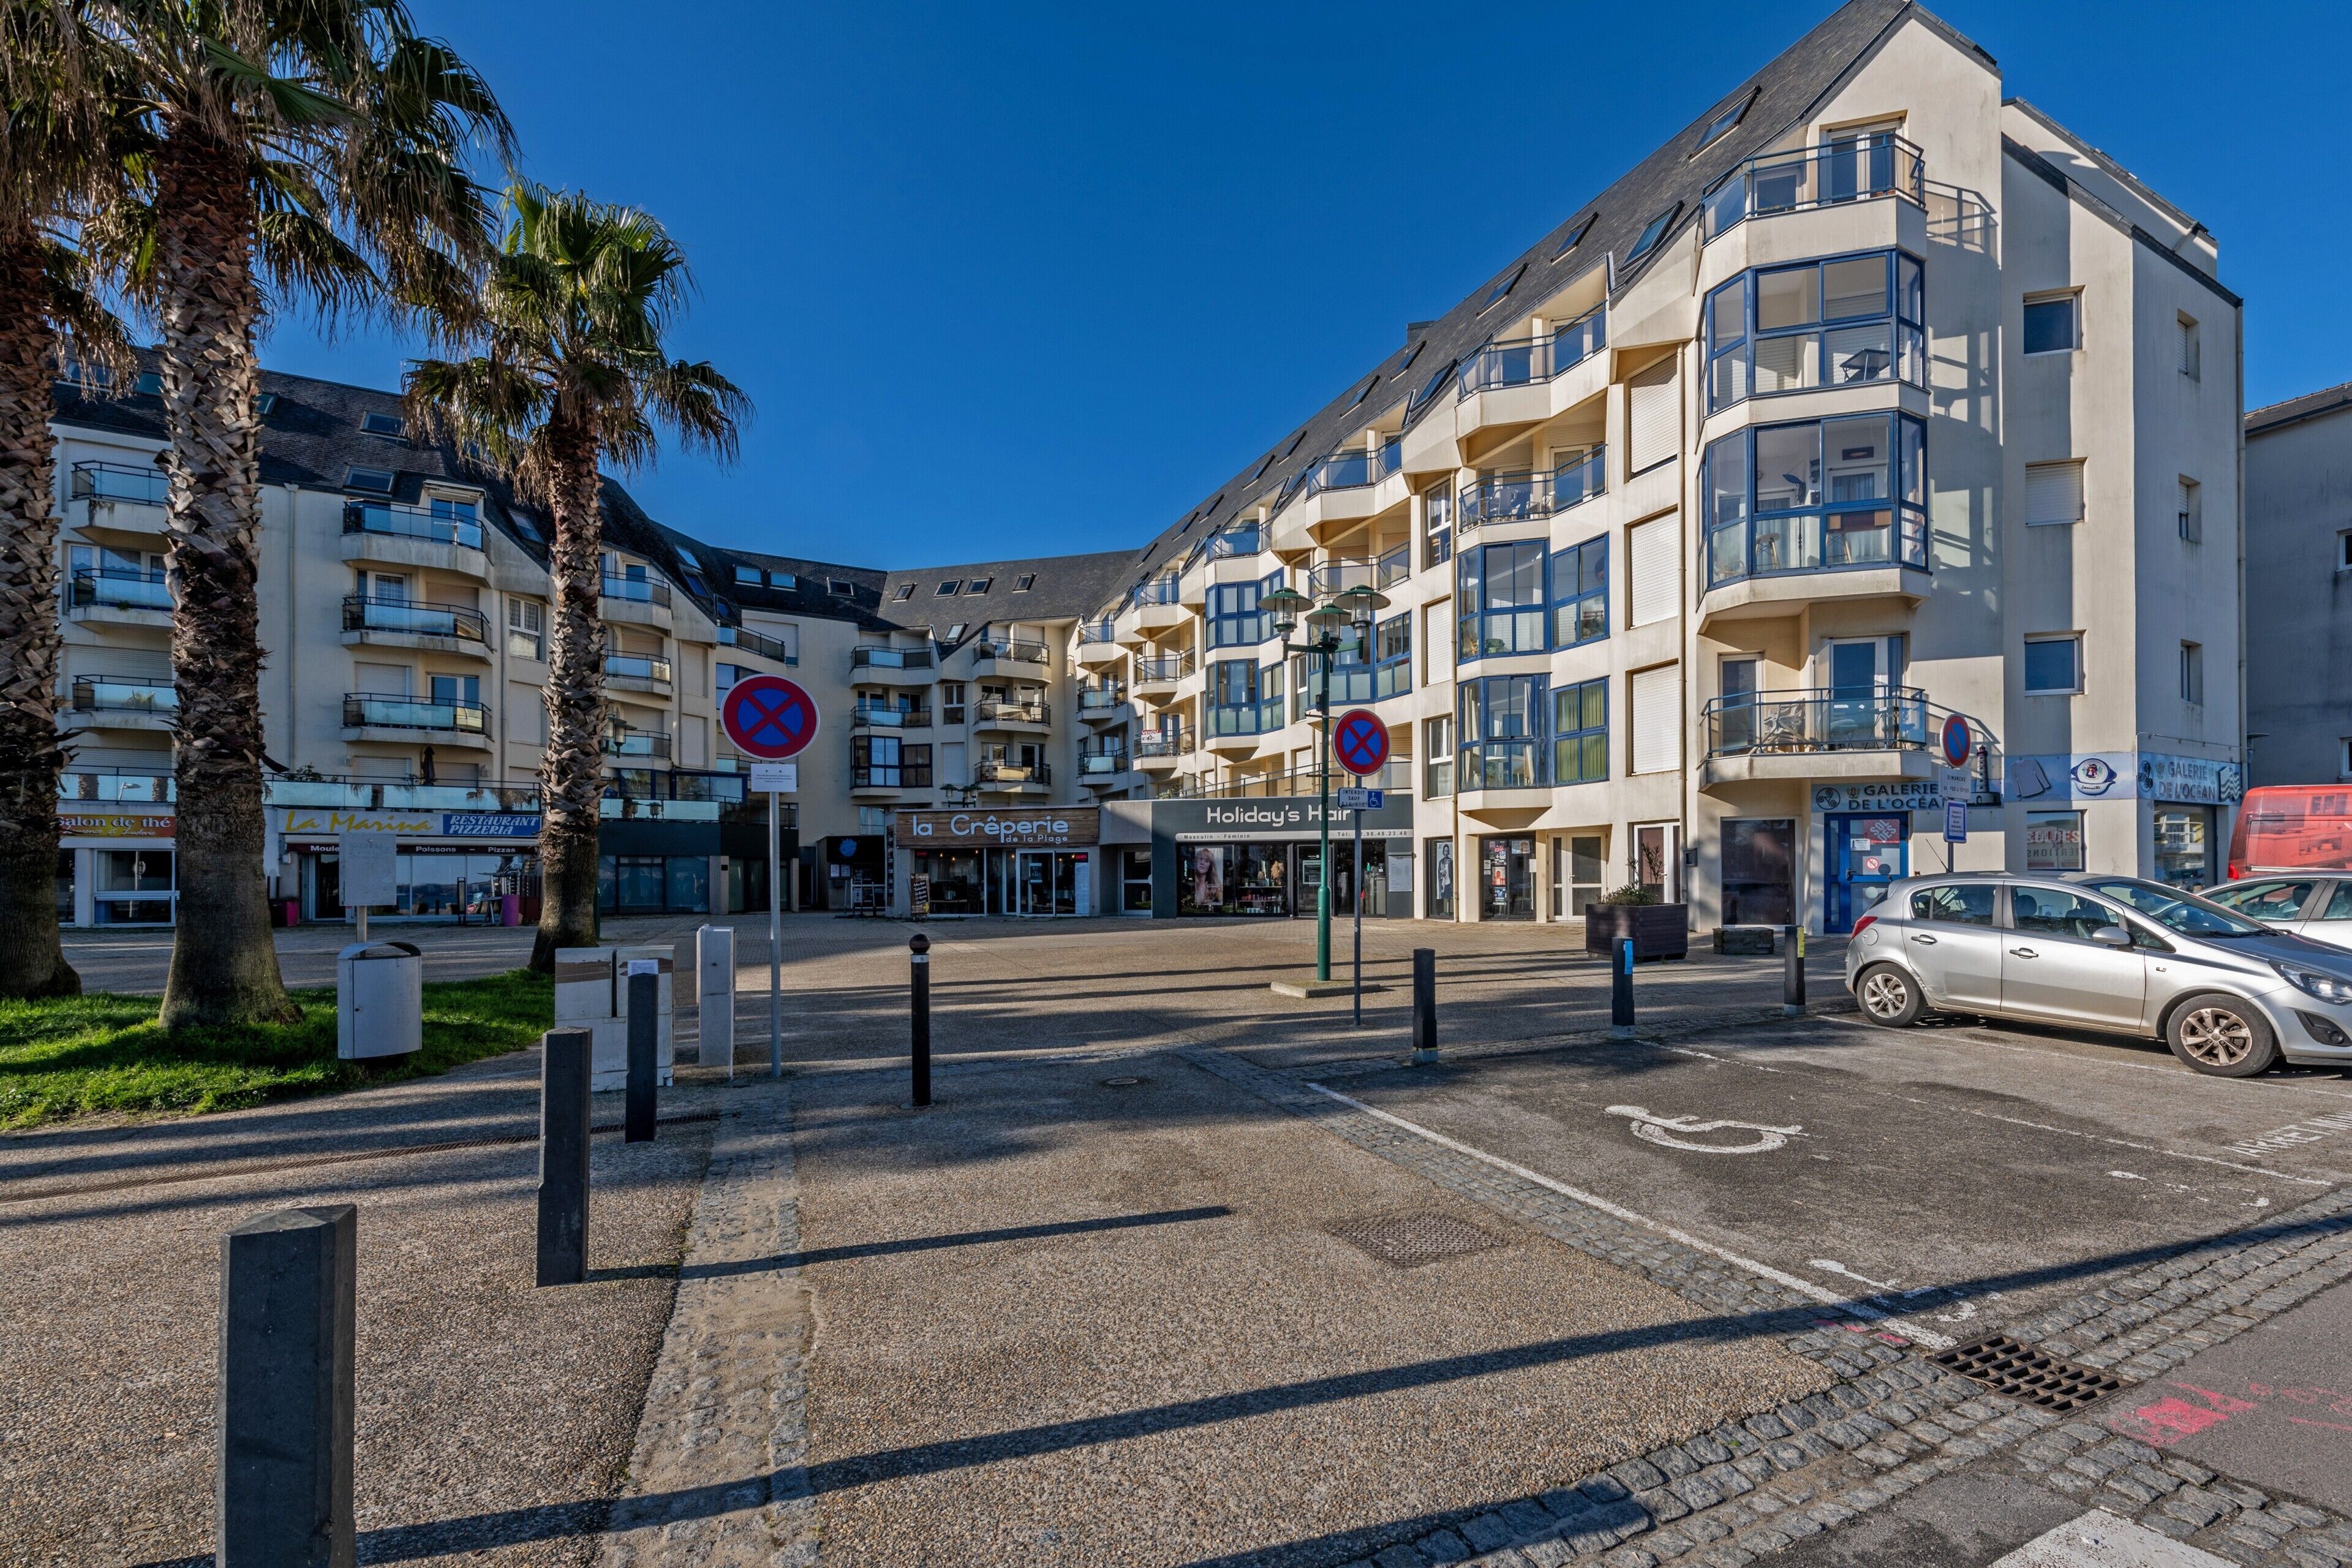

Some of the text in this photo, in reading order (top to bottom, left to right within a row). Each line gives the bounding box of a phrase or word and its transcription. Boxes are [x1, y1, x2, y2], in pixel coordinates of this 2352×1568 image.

[2168, 761, 2207, 780] GALERIE
[1864, 783, 1939, 796] GALERIE
[2159, 782, 2215, 800] DE L'OCÉAN
[1849, 799, 1871, 810] DE
[111, 817, 137, 827] de
[141, 818, 171, 827] thé
[285, 810, 434, 833] La Marina
[450, 815, 538, 826] RESTAURANT
[1207, 804, 1351, 827] Holiday's Hair
[449, 825, 513, 835] PIZZERIA
[912, 814, 1069, 843] la Crêperie
[1038, 834, 1068, 845] Plage
